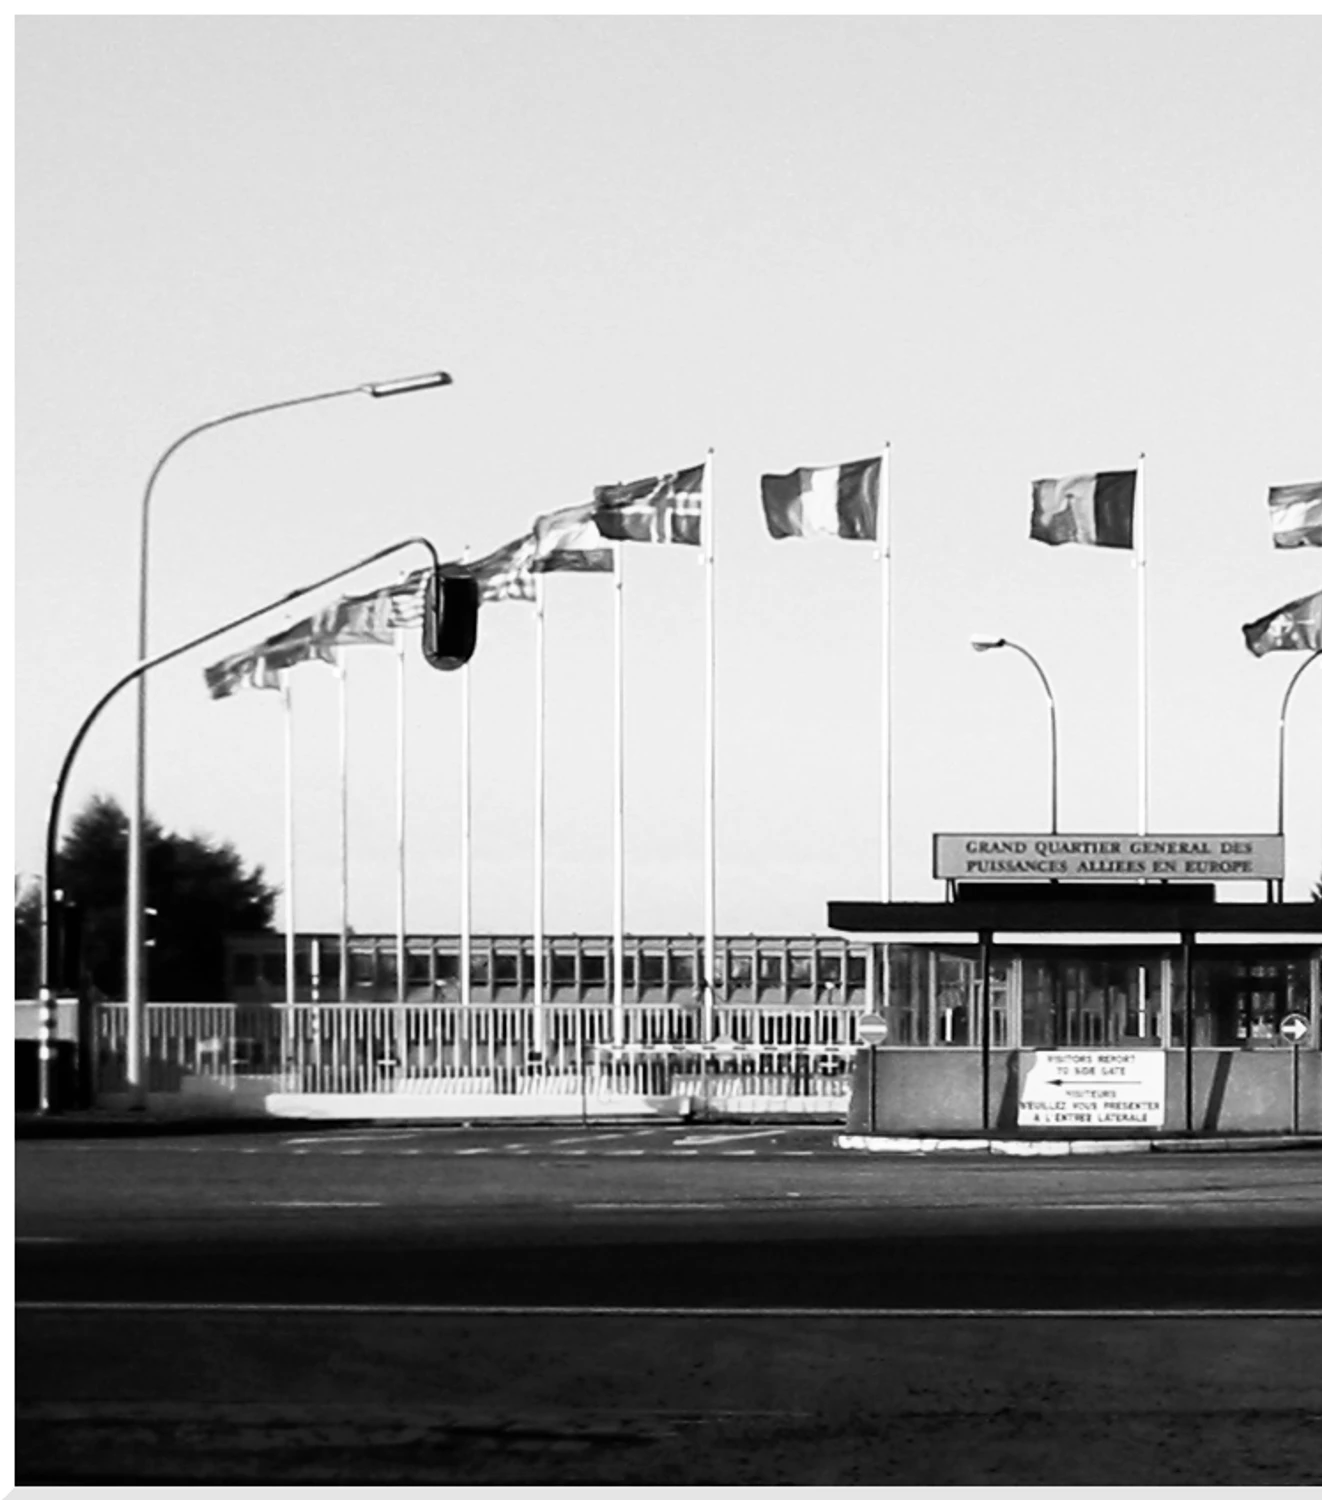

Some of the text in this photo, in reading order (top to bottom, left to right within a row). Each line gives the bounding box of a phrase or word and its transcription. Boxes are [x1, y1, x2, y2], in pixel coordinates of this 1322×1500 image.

[965, 840, 1253, 857] GRAND QUARTIER GENERAL DES
[966, 860, 1253, 873] PUISSANCES ALLIEES EN EUROPE
[1047, 1054, 1136, 1063] VISITORS REPORT
[1057, 1066, 1069, 1075] TO
[1101, 1066, 1126, 1075] GATE
[1065, 1089, 1116, 1098] VISITEURS
[1019, 1101, 1160, 1110] VEUILLEZ VOUS PRESENTER
[1098, 1113, 1148, 1122] LATERALE
